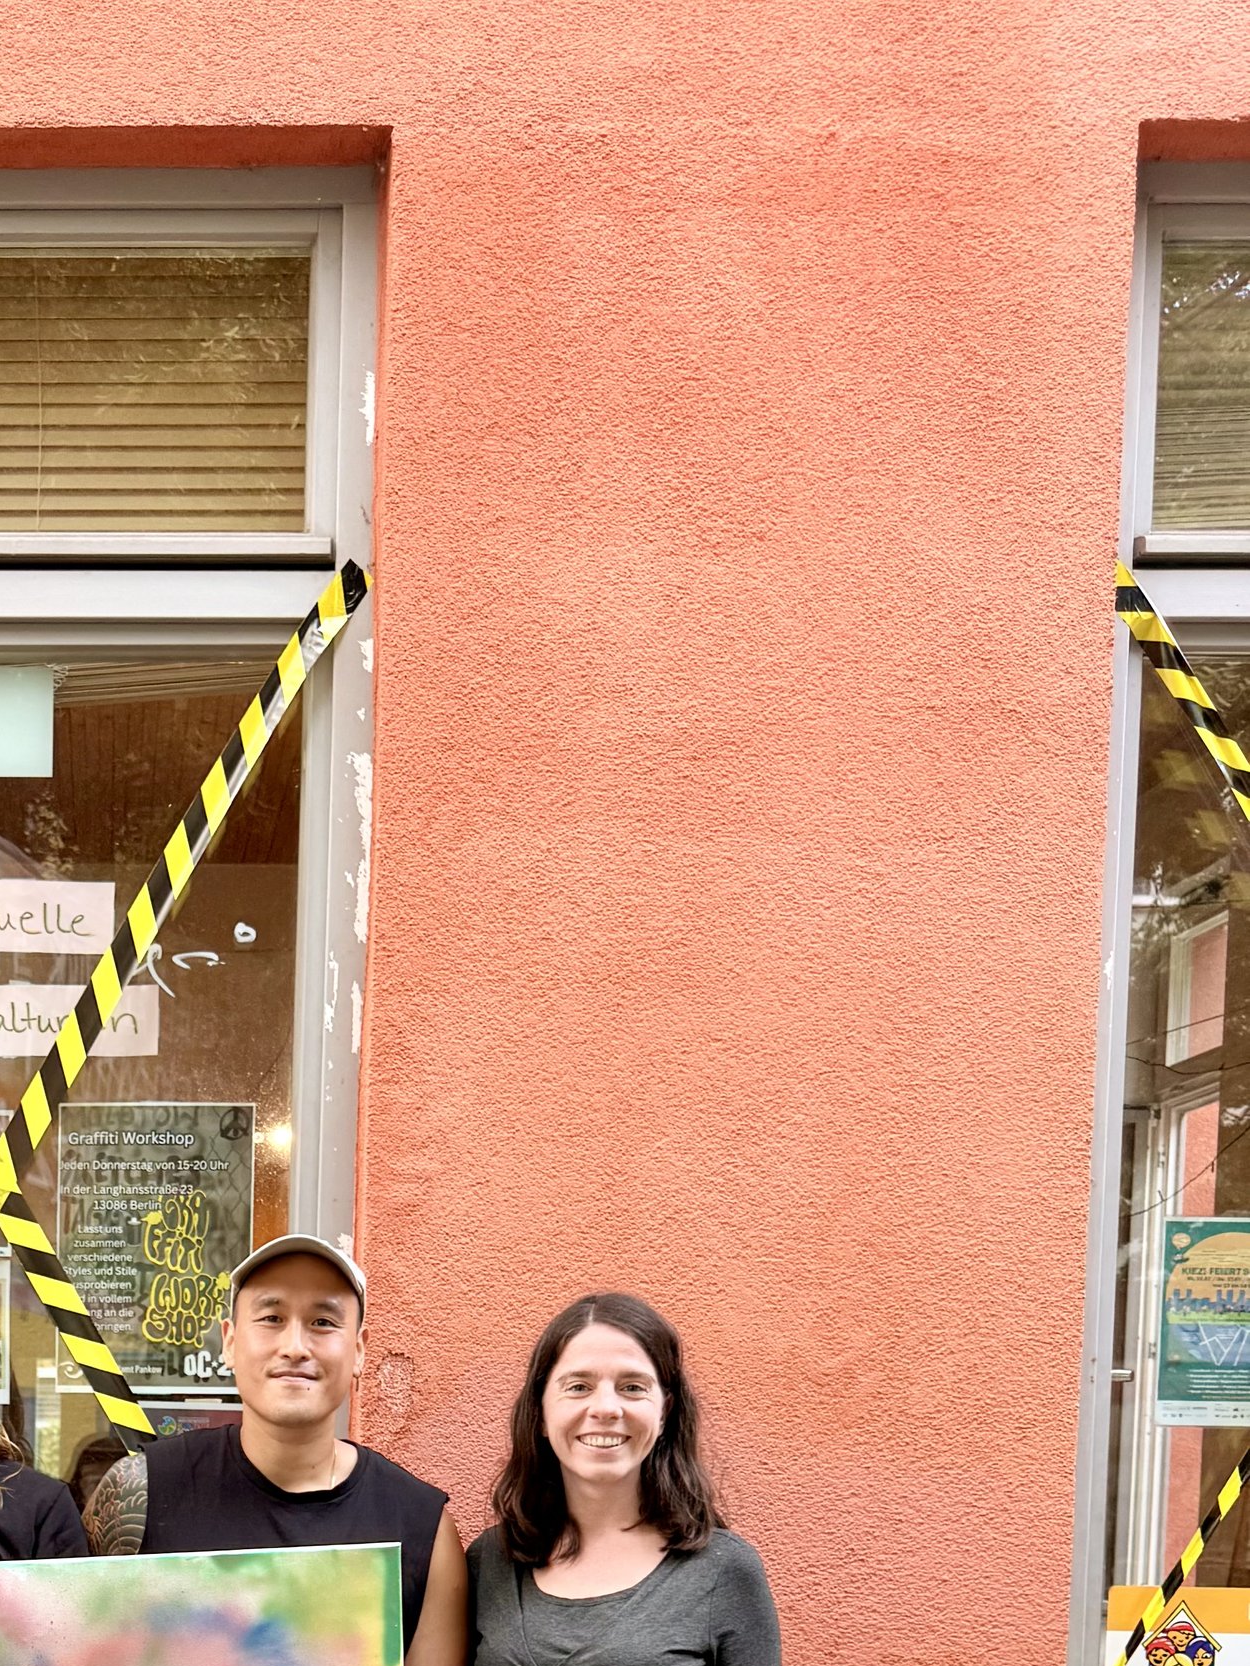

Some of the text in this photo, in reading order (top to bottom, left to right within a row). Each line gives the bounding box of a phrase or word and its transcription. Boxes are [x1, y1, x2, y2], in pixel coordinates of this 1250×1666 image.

[68, 1132, 194, 1147] Graffiti Workshop
[92, 1160, 153, 1172] Donnerstag
[155, 1162, 175, 1170] von
[177, 1161, 207, 1171] 15-20
[210, 1161, 229, 1171] Uhr
[72, 1185, 91, 1195] der
[93, 1185, 178, 1197] Langhansstraße
[180, 1185, 194, 1195] 23
[93, 1200, 162, 1211] 13086 Berlin
[77, 1224, 124, 1235] Lasst uns
[73, 1239, 126, 1249] zusammen
[67, 1253, 133, 1263] verschiedene
[63, 1267, 138, 1278] Styles und Stile
[73, 1281, 132, 1292] usprobieren
[87, 1295, 97, 1303] in
[99, 1295, 132, 1304] vollem
[104, 1309, 119, 1317] an
[120, 1308, 134, 1317] die
[134, 1364, 163, 1374] Pankow
